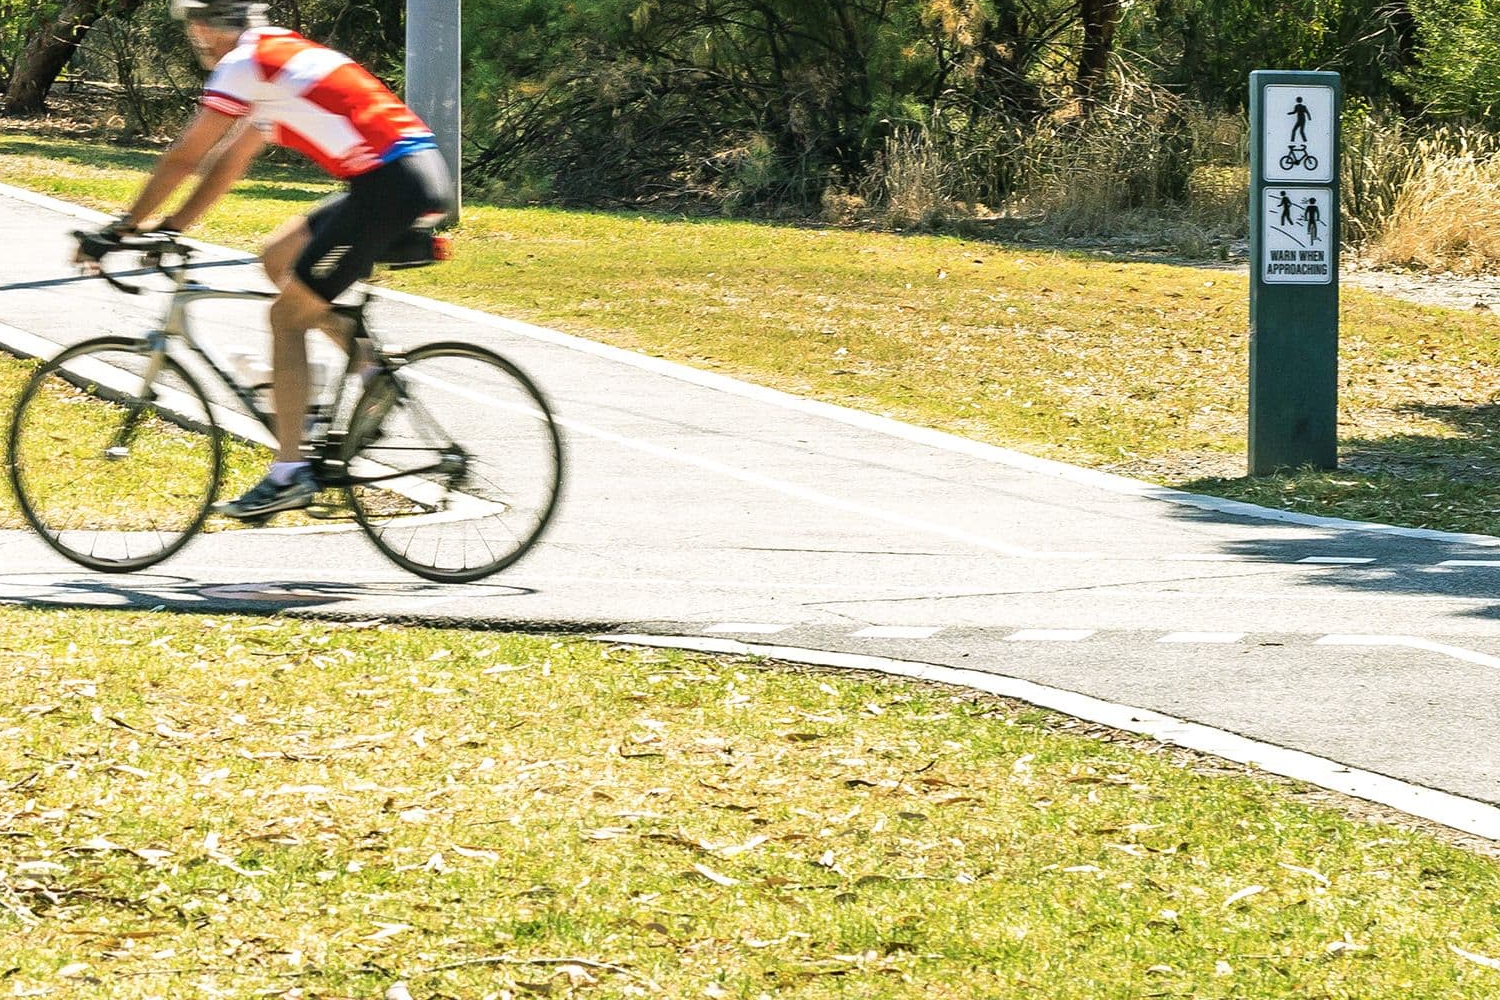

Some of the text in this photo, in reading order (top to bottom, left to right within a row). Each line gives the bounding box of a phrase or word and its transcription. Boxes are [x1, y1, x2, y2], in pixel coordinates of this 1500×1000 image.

[1270, 250, 1324, 261] WARN WHEN
[1267, 263, 1327, 275] APPROACHING
